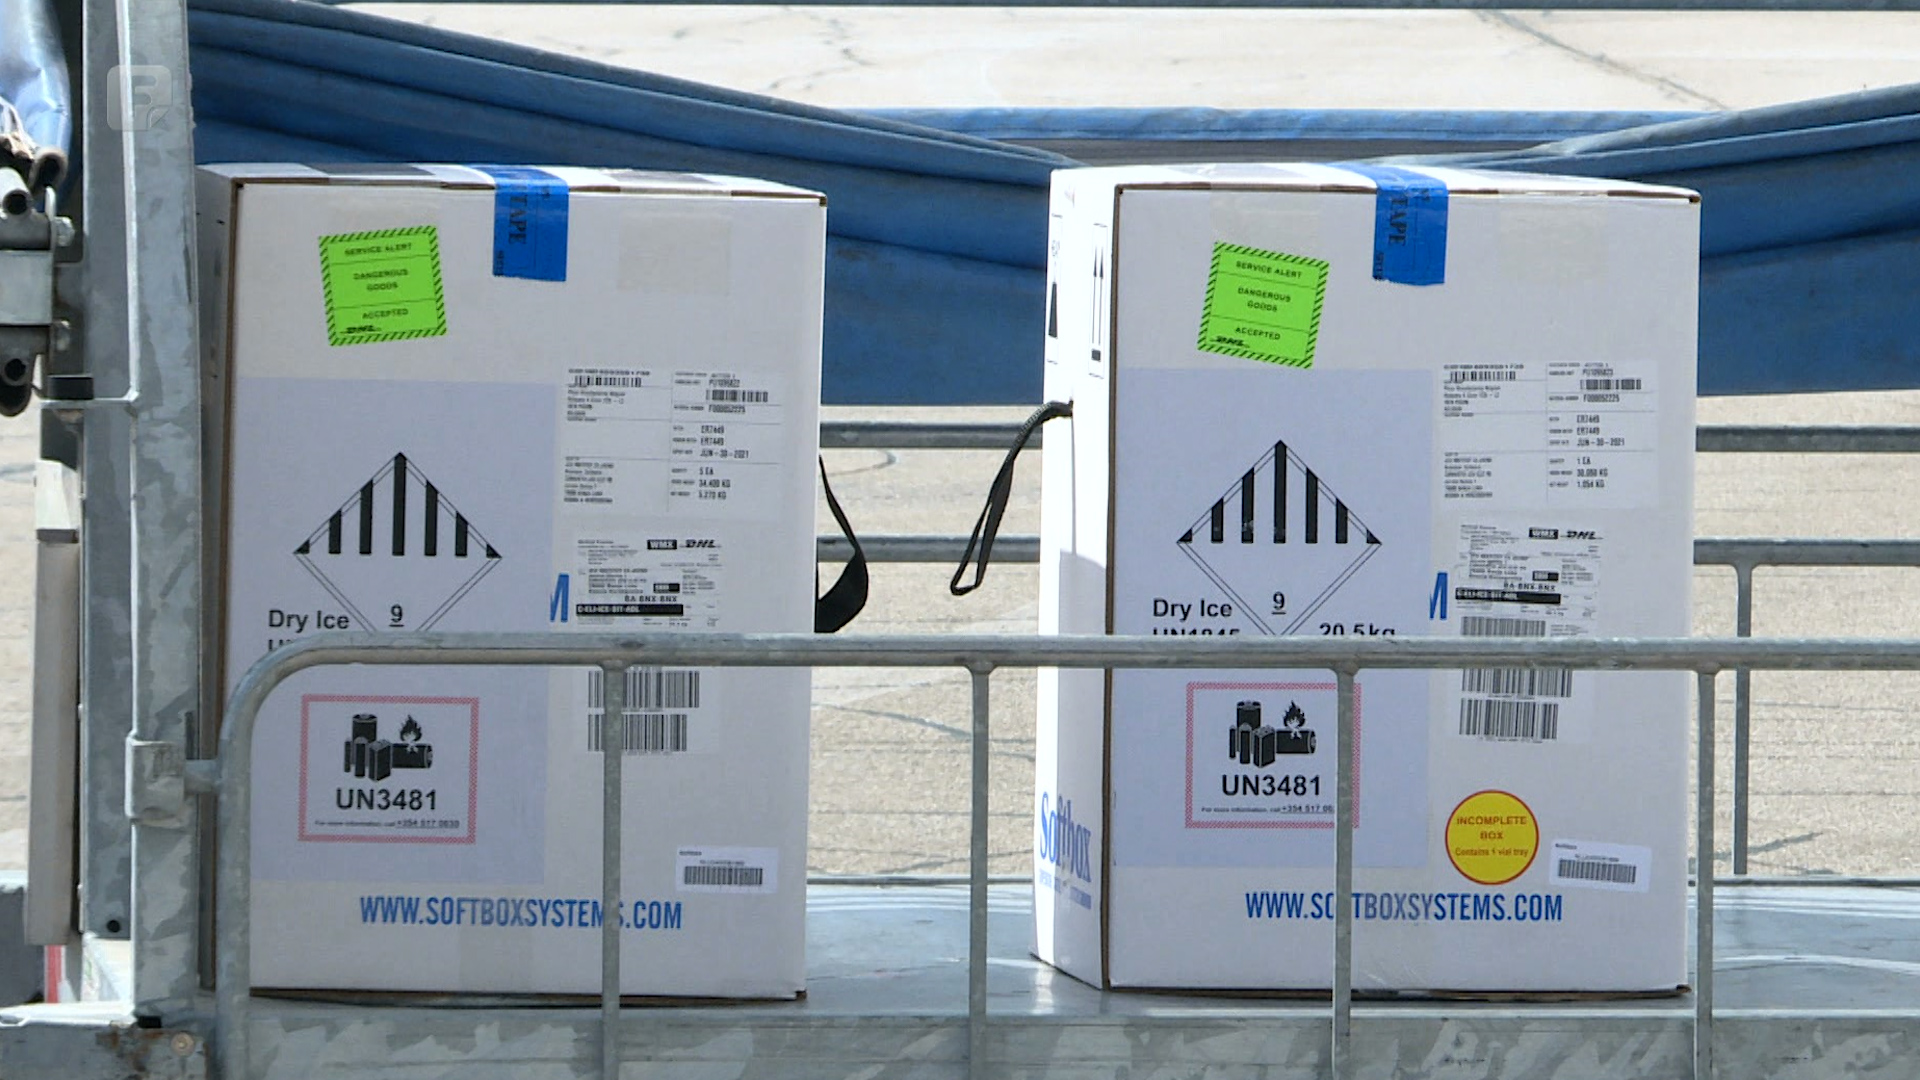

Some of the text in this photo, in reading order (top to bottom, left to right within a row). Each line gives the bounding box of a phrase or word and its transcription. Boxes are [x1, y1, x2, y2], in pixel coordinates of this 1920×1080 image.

[508, 195, 529, 245] TAPE
[1388, 198, 1408, 247] TAPE
[344, 242, 412, 257] SERVICE ALERT
[353, 268, 409, 281] DANGEROUS
[1235, 260, 1303, 281] SERVICE ALERT
[366, 281, 399, 292] GOODS
[1237, 286, 1292, 303] DANGEROUS
[362, 308, 409, 320] ACCEPTED
[1246, 300, 1279, 313] GOODS
[1235, 327, 1281, 341] ACCEPTED
[1565, 530, 1598, 541] DHL
[649, 541, 676, 549] WMX
[684, 539, 717, 549] DHL
[1272, 591, 1286, 611] 9
[390, 604, 404, 622] 9
[1153, 599, 1233, 622] Dry Ice
[269, 609, 349, 634] Dry Ice
[1222, 774, 1320, 797] UN3481
[336, 787, 437, 811] UN3481
[1457, 815, 1527, 826] INCOMPLETE
[1040, 791, 1091, 883] Softbox
[1480, 830, 1504, 841] BOX
[1455, 846, 1489, 857] Contains
[1498, 847, 1512, 856] vial
[1513, 847, 1529, 859] tray
[1246, 892, 1562, 922] WWW.SOTBOXSYSTEMS.COM
